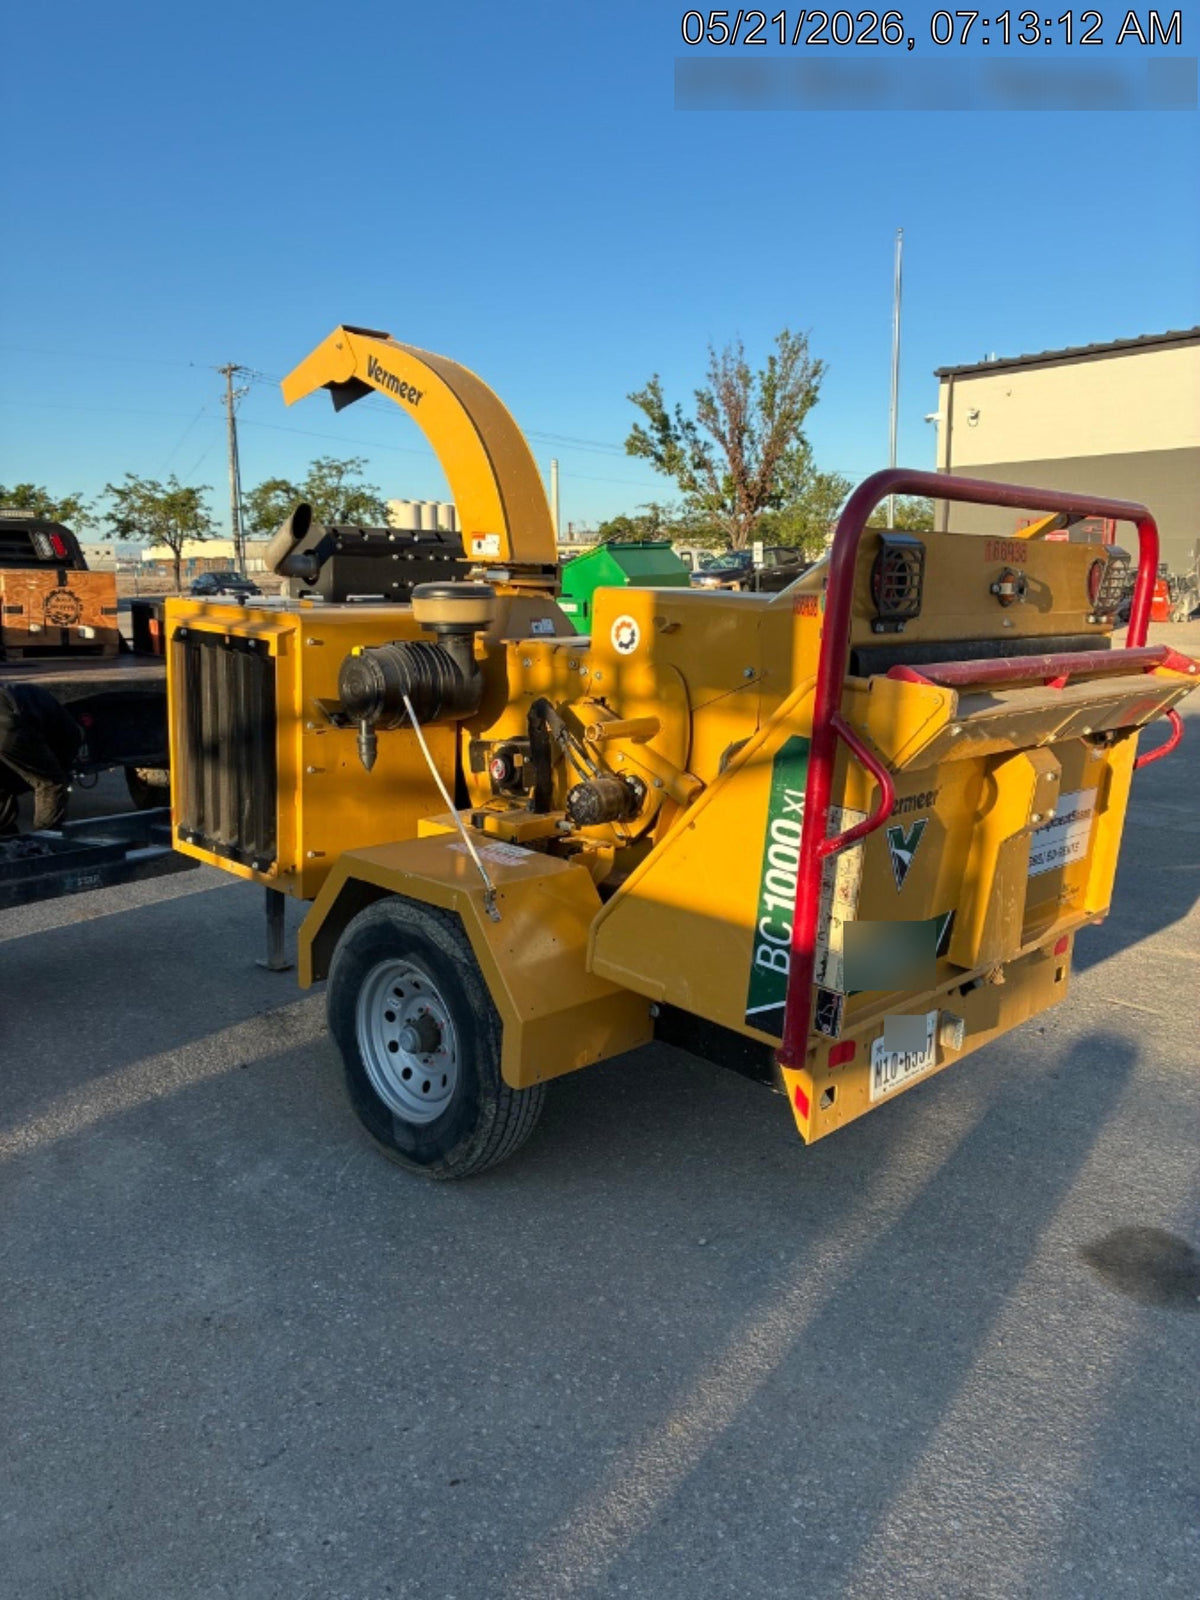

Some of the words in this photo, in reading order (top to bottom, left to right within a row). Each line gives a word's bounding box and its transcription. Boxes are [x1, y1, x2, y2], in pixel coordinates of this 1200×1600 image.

[367, 354, 424, 407] Vermeer
[890, 789, 940, 817] ermeer
[762, 818, 802, 912] 1000
[755, 916, 793, 977] BC
